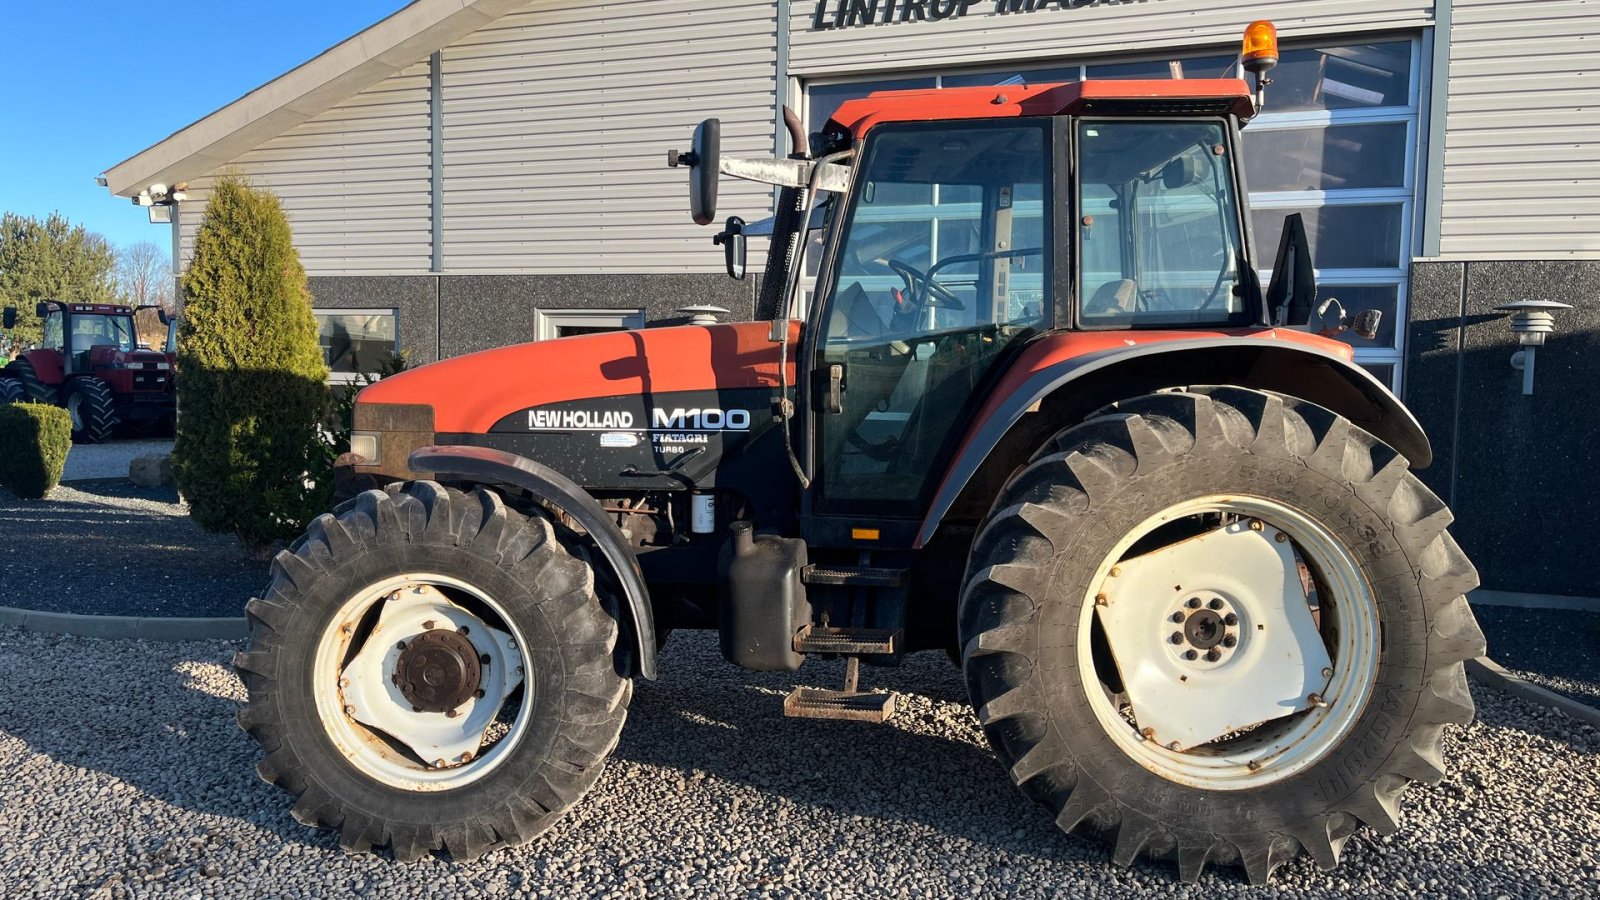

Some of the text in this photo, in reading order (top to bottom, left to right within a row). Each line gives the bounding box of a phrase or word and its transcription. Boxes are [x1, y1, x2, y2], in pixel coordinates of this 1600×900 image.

[528, 411, 634, 428] NEW HOLLAND
[652, 408, 750, 428] M100
[652, 433, 708, 443] FIATAGRI
[654, 446, 685, 454] TURBO
